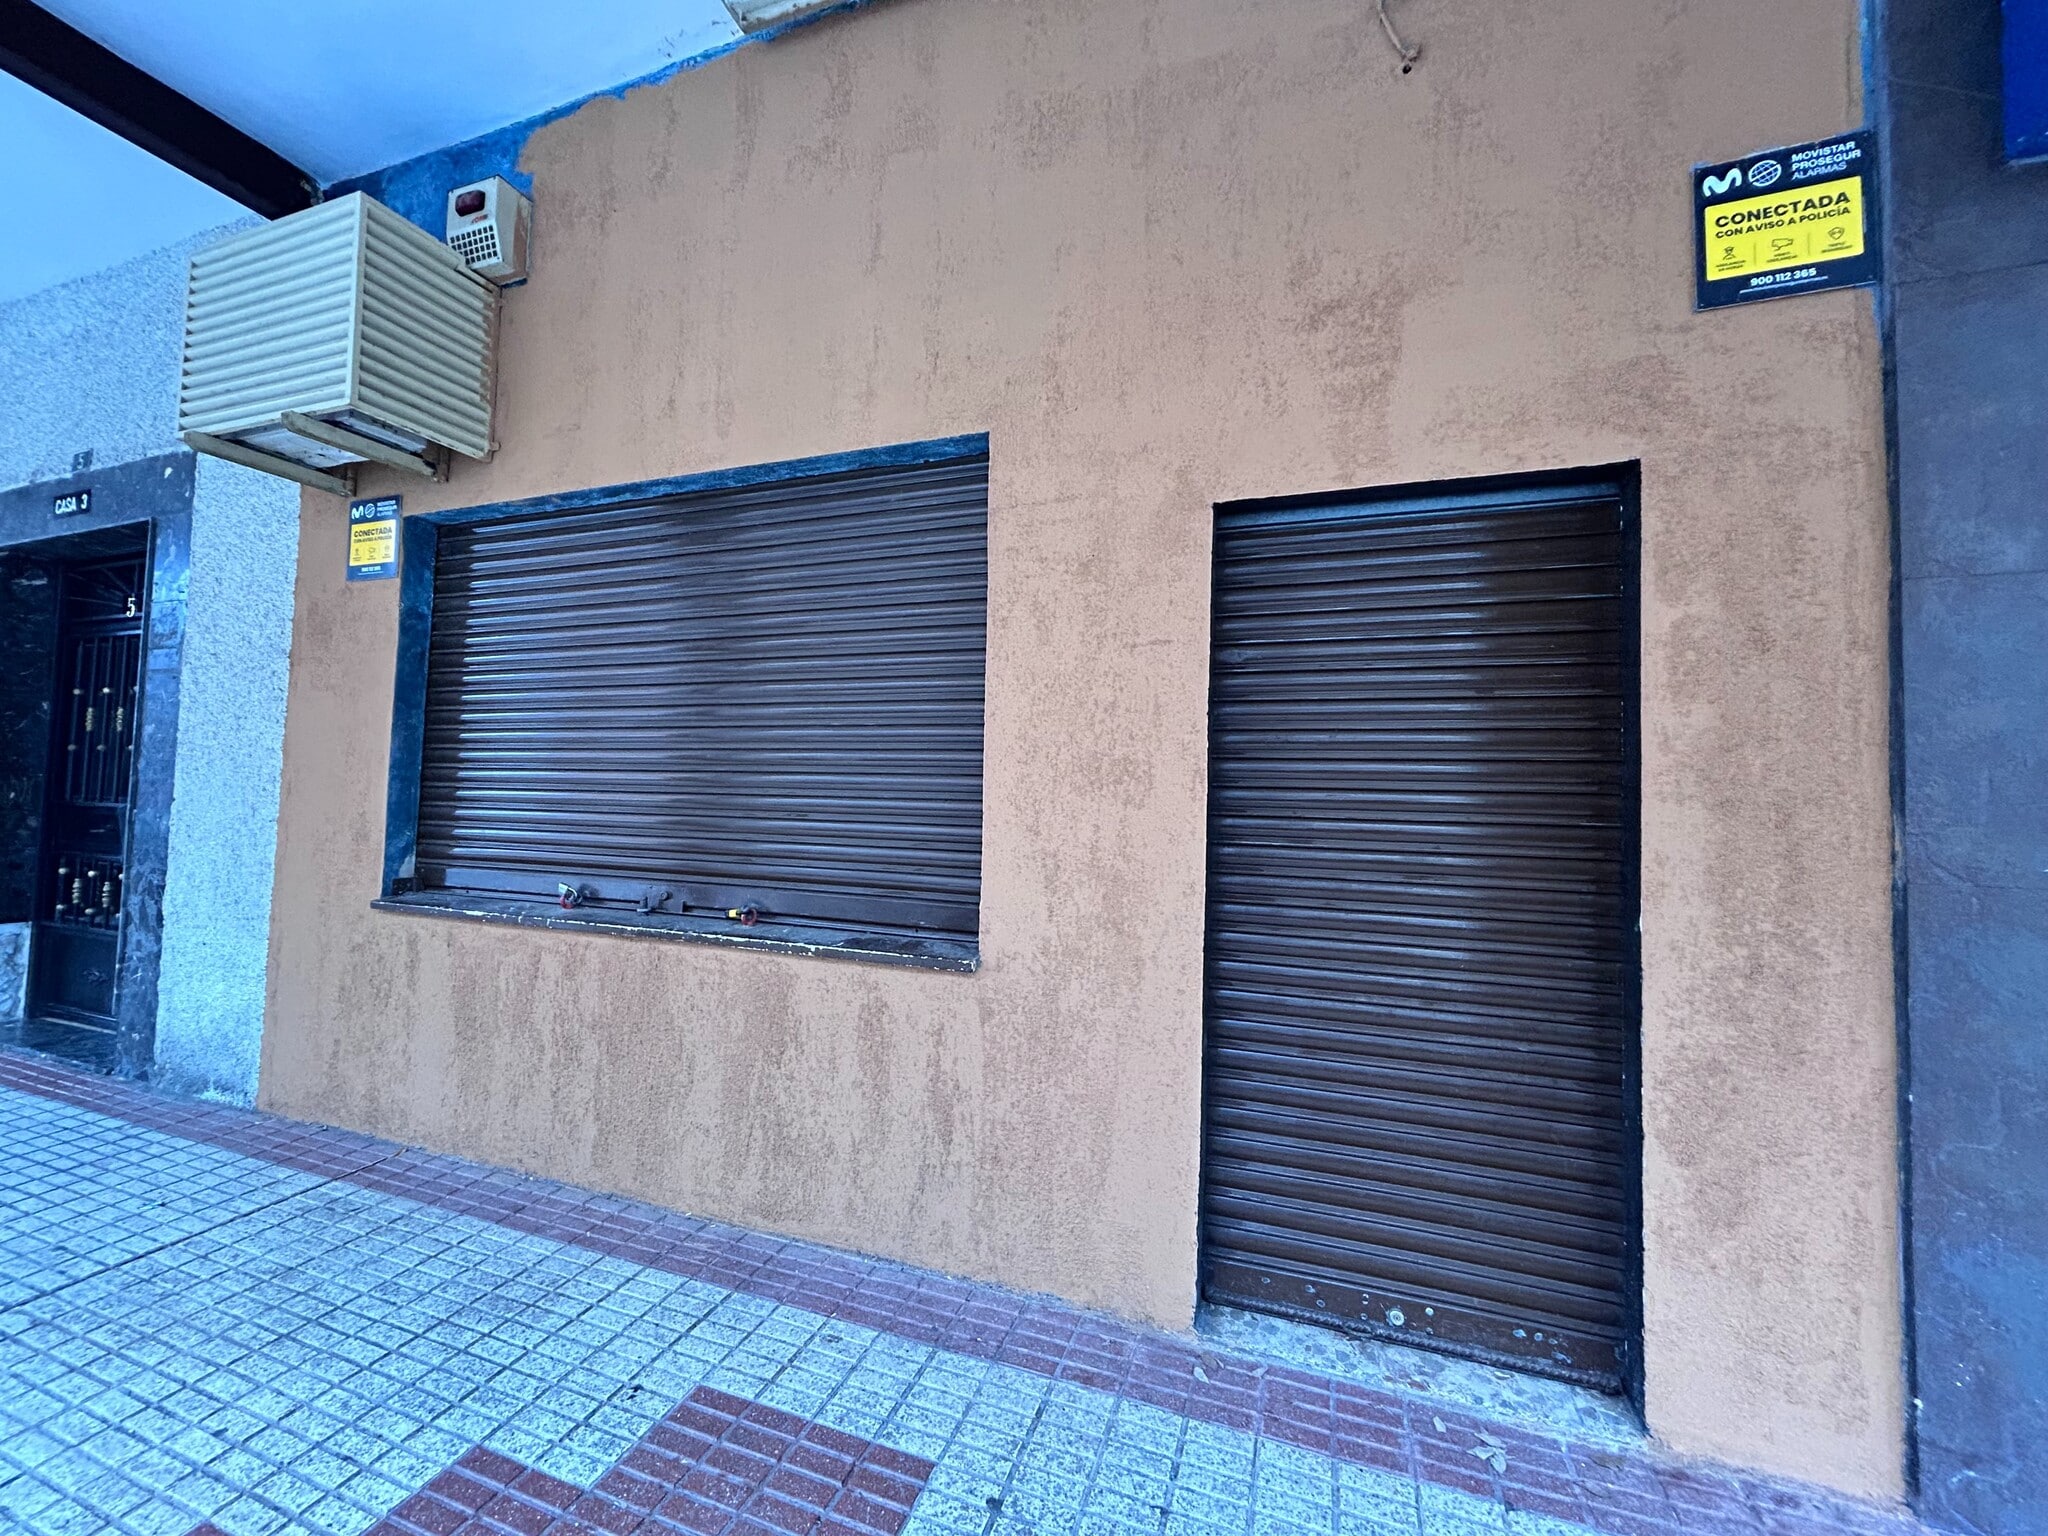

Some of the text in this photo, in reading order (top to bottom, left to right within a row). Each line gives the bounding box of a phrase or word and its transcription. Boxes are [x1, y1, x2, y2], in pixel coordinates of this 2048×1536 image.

[1791, 140, 1856, 162] MOVISTAR
[1791, 149, 1862, 171] PROSEGUR
[1791, 161, 1847, 181] ALARMAS
[1715, 191, 1850, 227] CONECTADA
[1715, 205, 1851, 239] CON AVISO A POLICÍA
[1750, 274, 1774, 287] 900
[1775, 271, 1792, 282] 112
[1793, 267, 1817, 280] 365
[55, 493, 88, 515] CASA 3
[126, 597, 136, 617] 5
